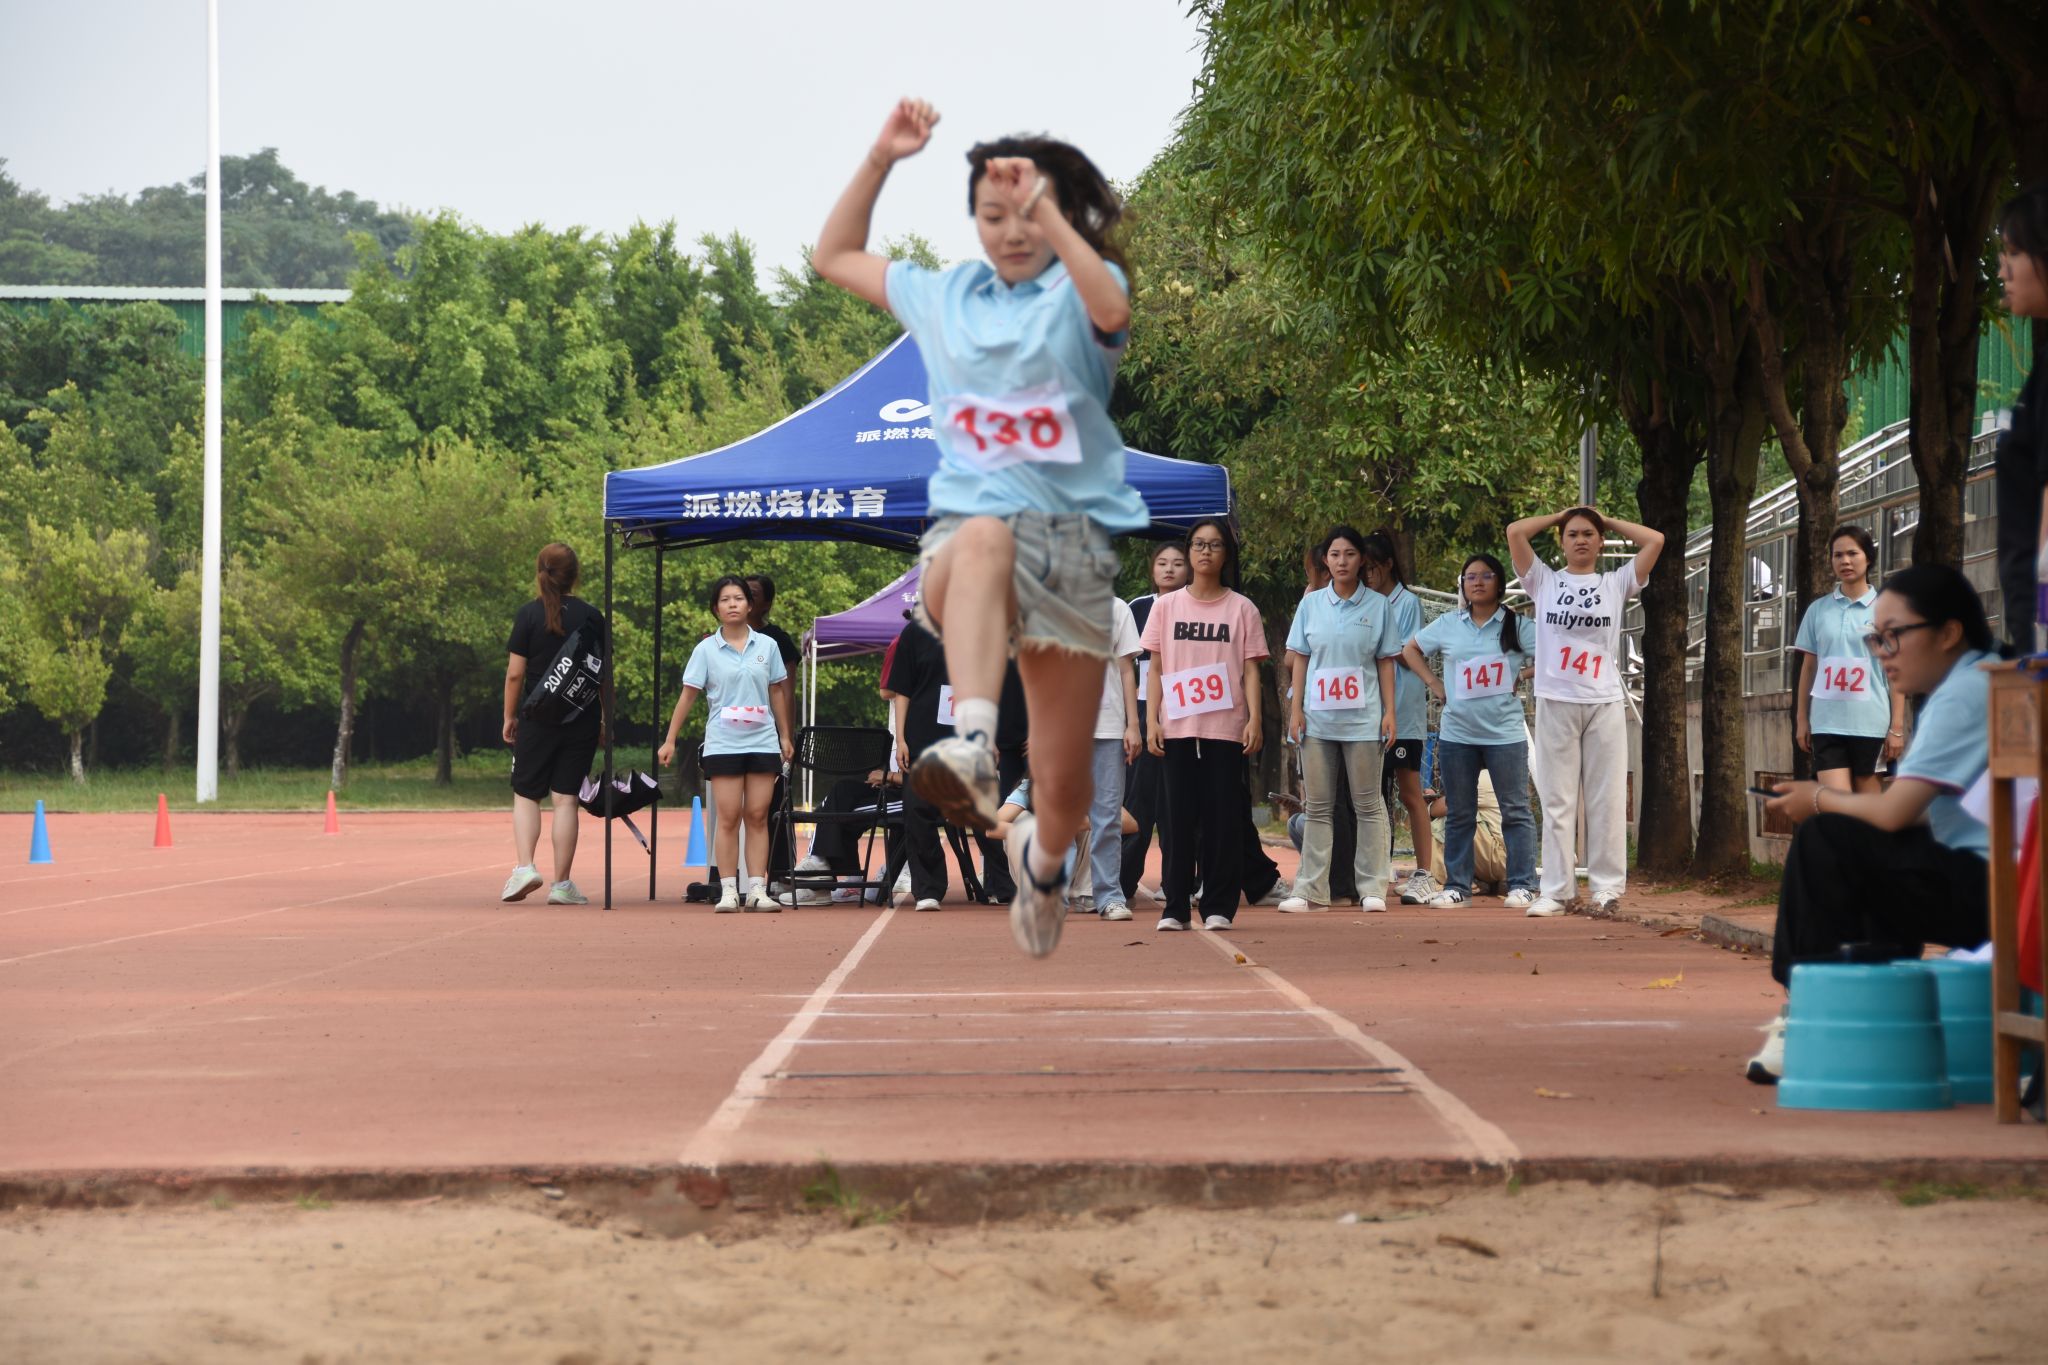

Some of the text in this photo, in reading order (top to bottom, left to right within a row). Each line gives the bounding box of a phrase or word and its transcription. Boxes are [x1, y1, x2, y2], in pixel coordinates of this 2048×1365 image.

[682, 487, 887, 518] 派燃烧体育
[1174, 622, 1230, 643] BELLA
[1546, 610, 1611, 630] milyroom
[544, 656, 573, 693] 20/20
[1463, 662, 1503, 690] 147
[1560, 646, 1602, 679] 141
[567, 677, 585, 698] FILA
[1172, 674, 1224, 707] 139
[1317, 676, 1359, 702] 146
[1824, 666, 1865, 692] 142
